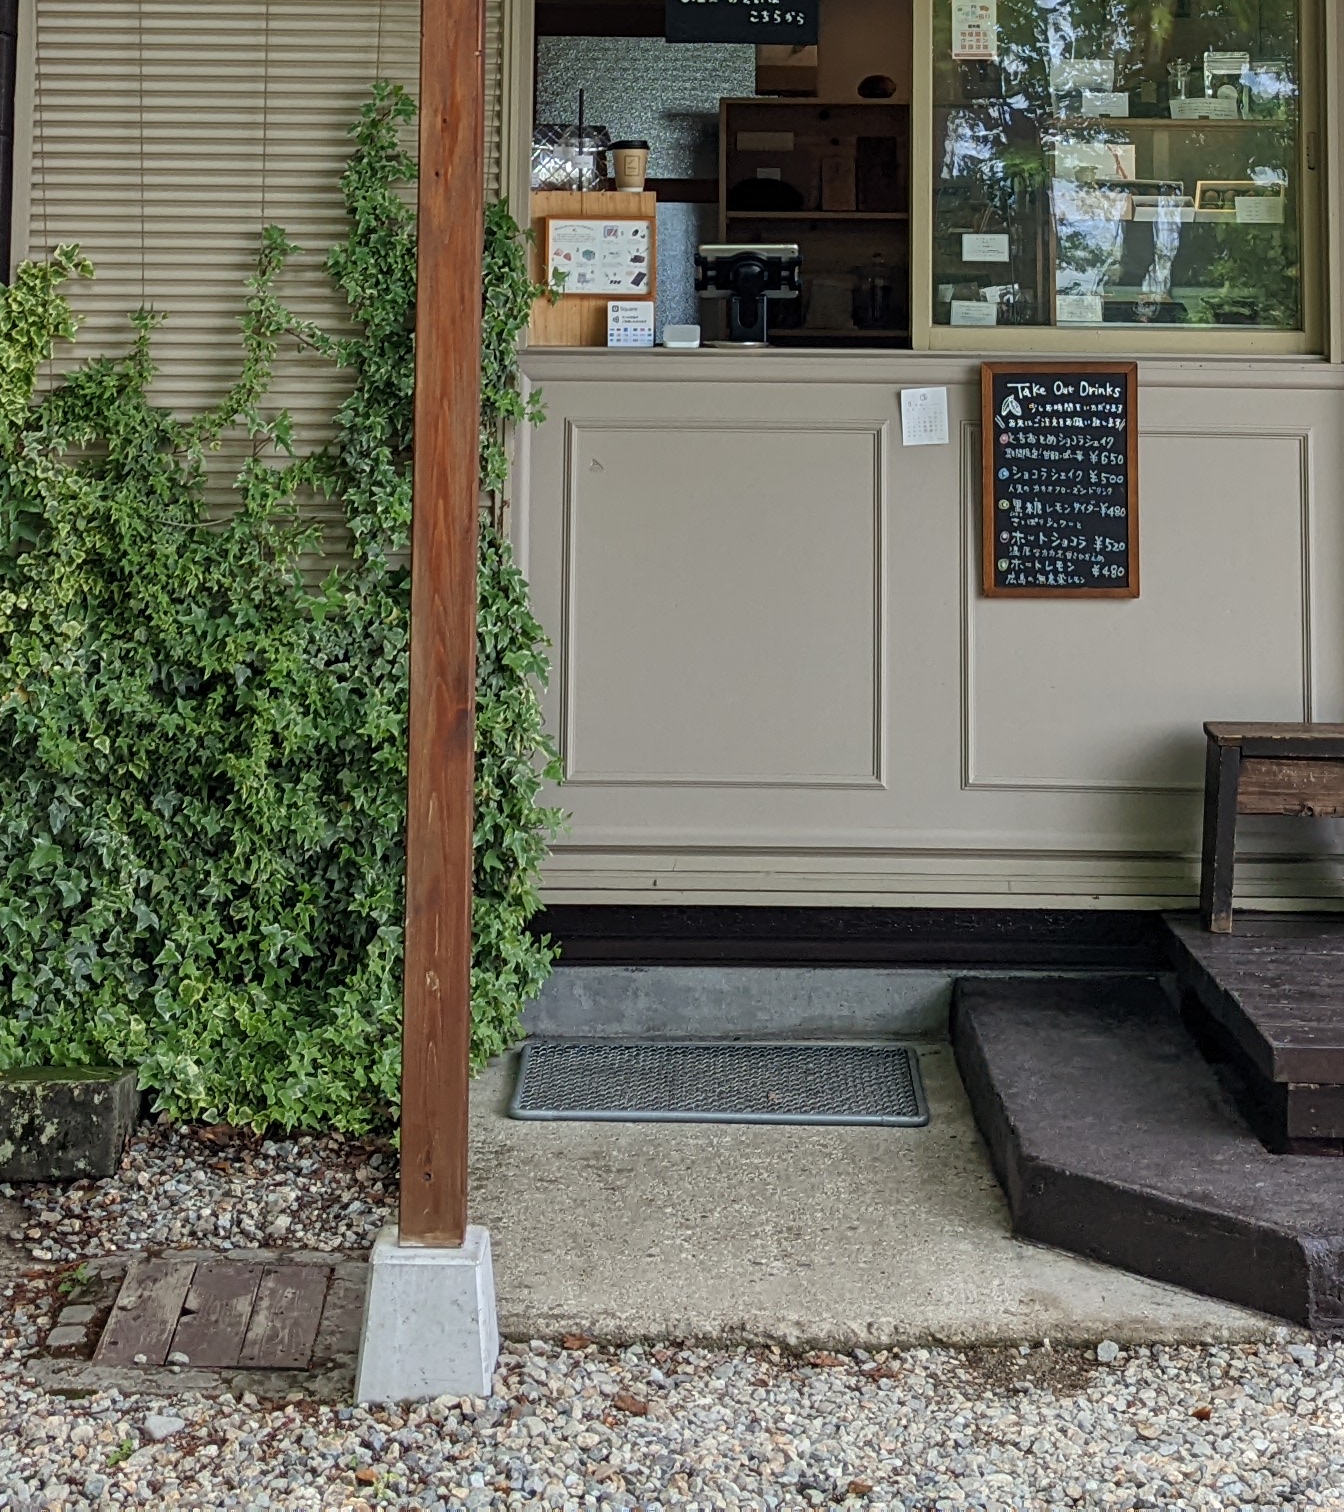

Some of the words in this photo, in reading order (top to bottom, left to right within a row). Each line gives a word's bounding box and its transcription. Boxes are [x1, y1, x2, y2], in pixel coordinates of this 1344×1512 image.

[750, 10, 805, 25] こちらから
[1007, 382, 1046, 399] Take
[1053, 381, 1074, 395] Out
[1079, 381, 1121, 398] Drinks
[1089, 450, 1124, 465] ¥650
[1012, 466, 1083, 481] ショコラシェイク
[1089, 470, 1124, 484] ¥500
[1100, 503, 1126, 517] ¥480
[1094, 536, 1126, 551] ¥520
[1092, 564, 1125, 578] ¥480
